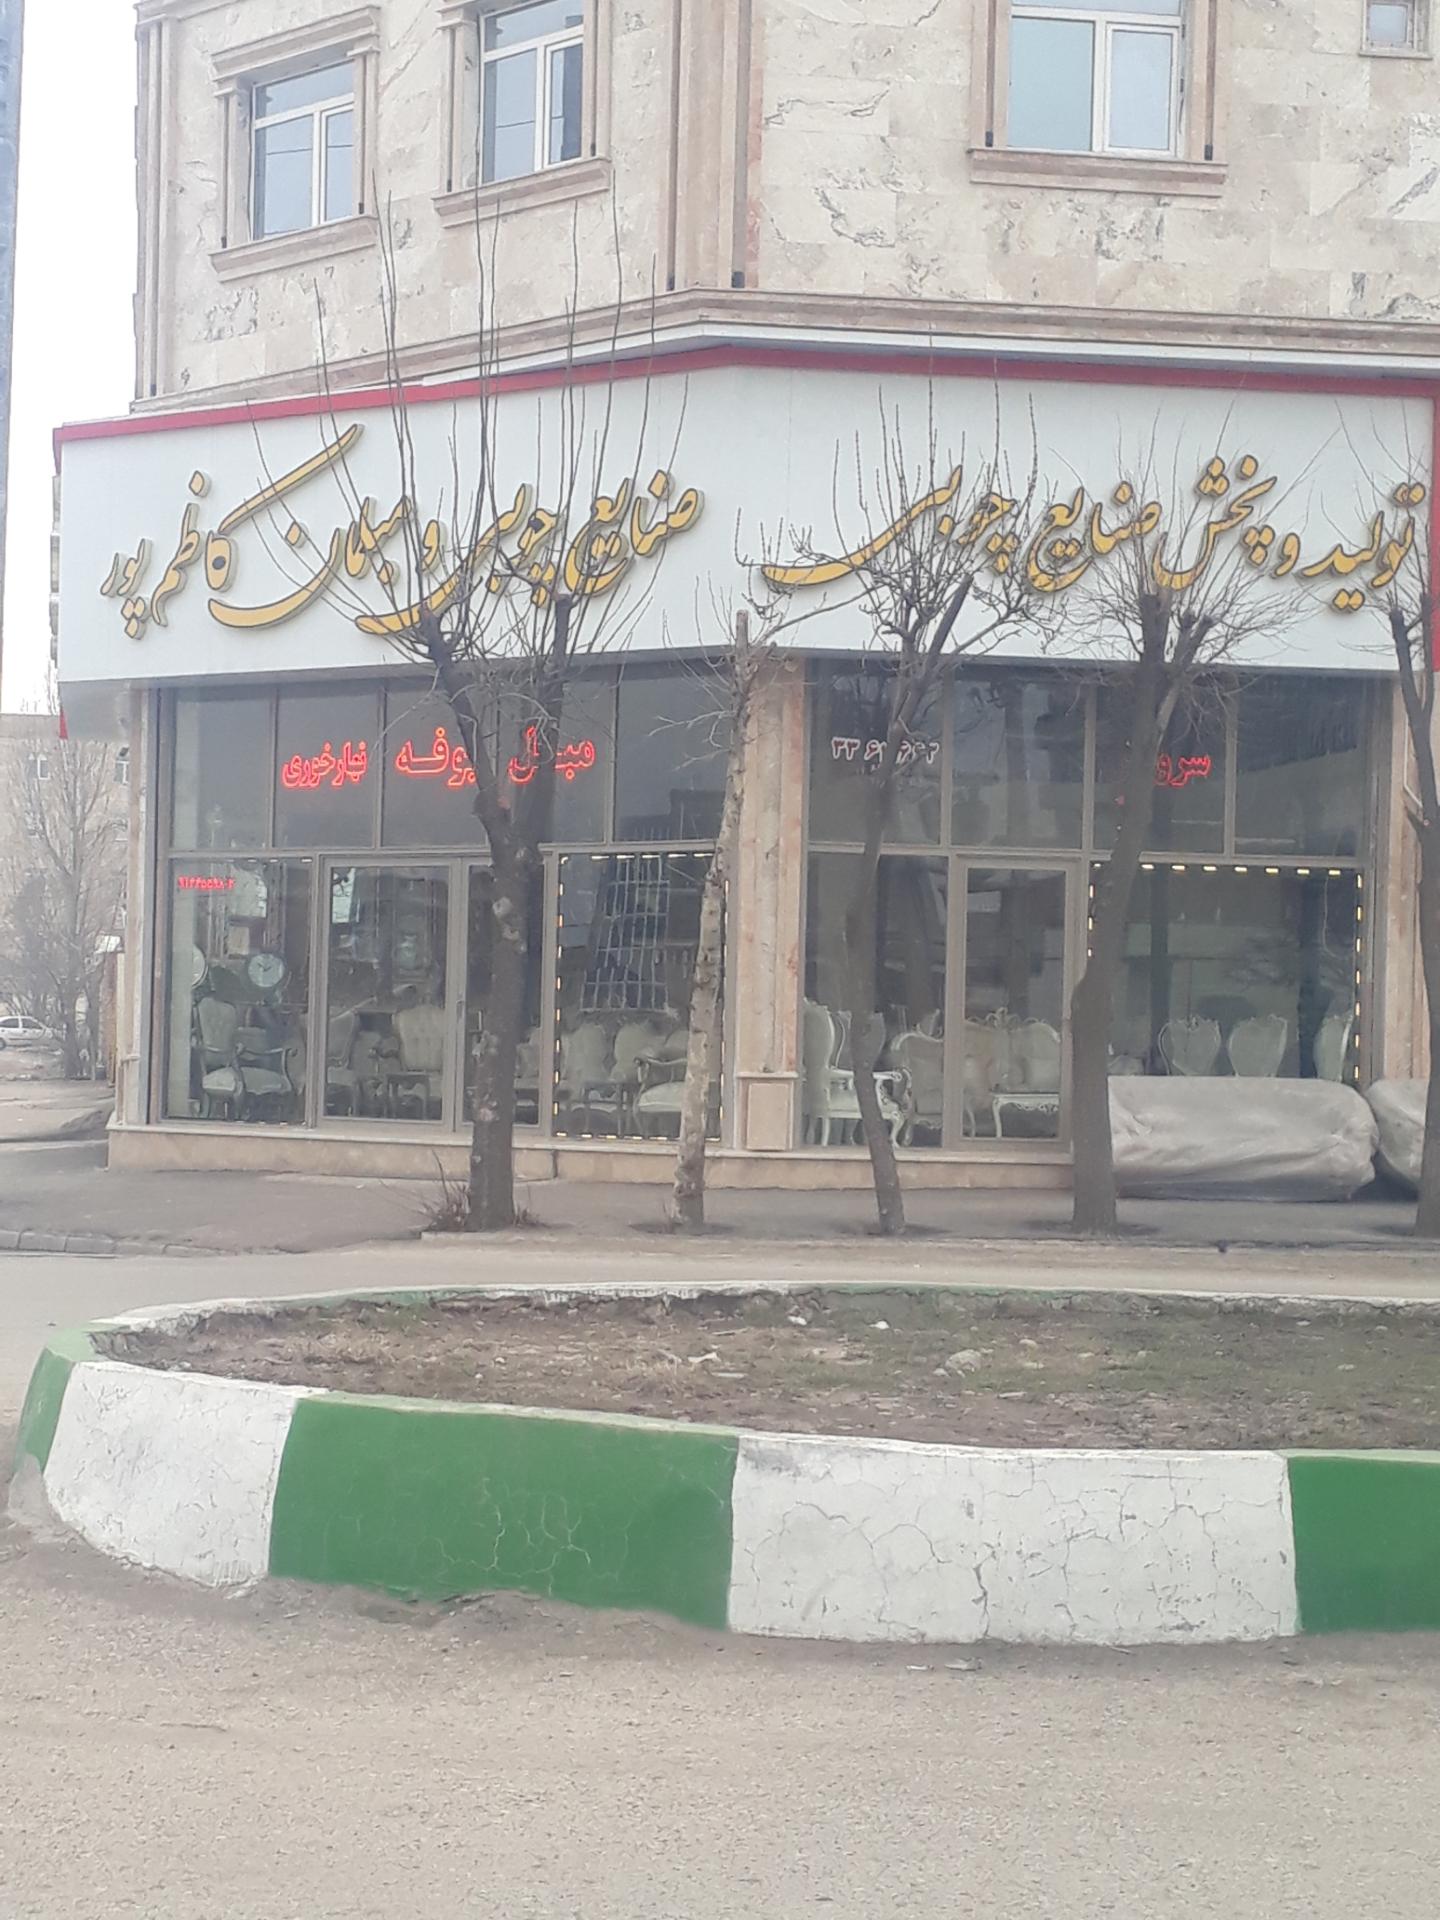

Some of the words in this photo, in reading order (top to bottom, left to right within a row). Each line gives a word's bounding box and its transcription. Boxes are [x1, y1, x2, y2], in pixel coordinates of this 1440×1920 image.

[420, 519, 442, 574] و
[563, 469, 705, 597] صنایع
[1026, 480, 1163, 594] صنایع
[1152, 453, 1278, 592] پخش
[1273, 532, 1301, 577] و
[1301, 482, 1426, 611] تولید
